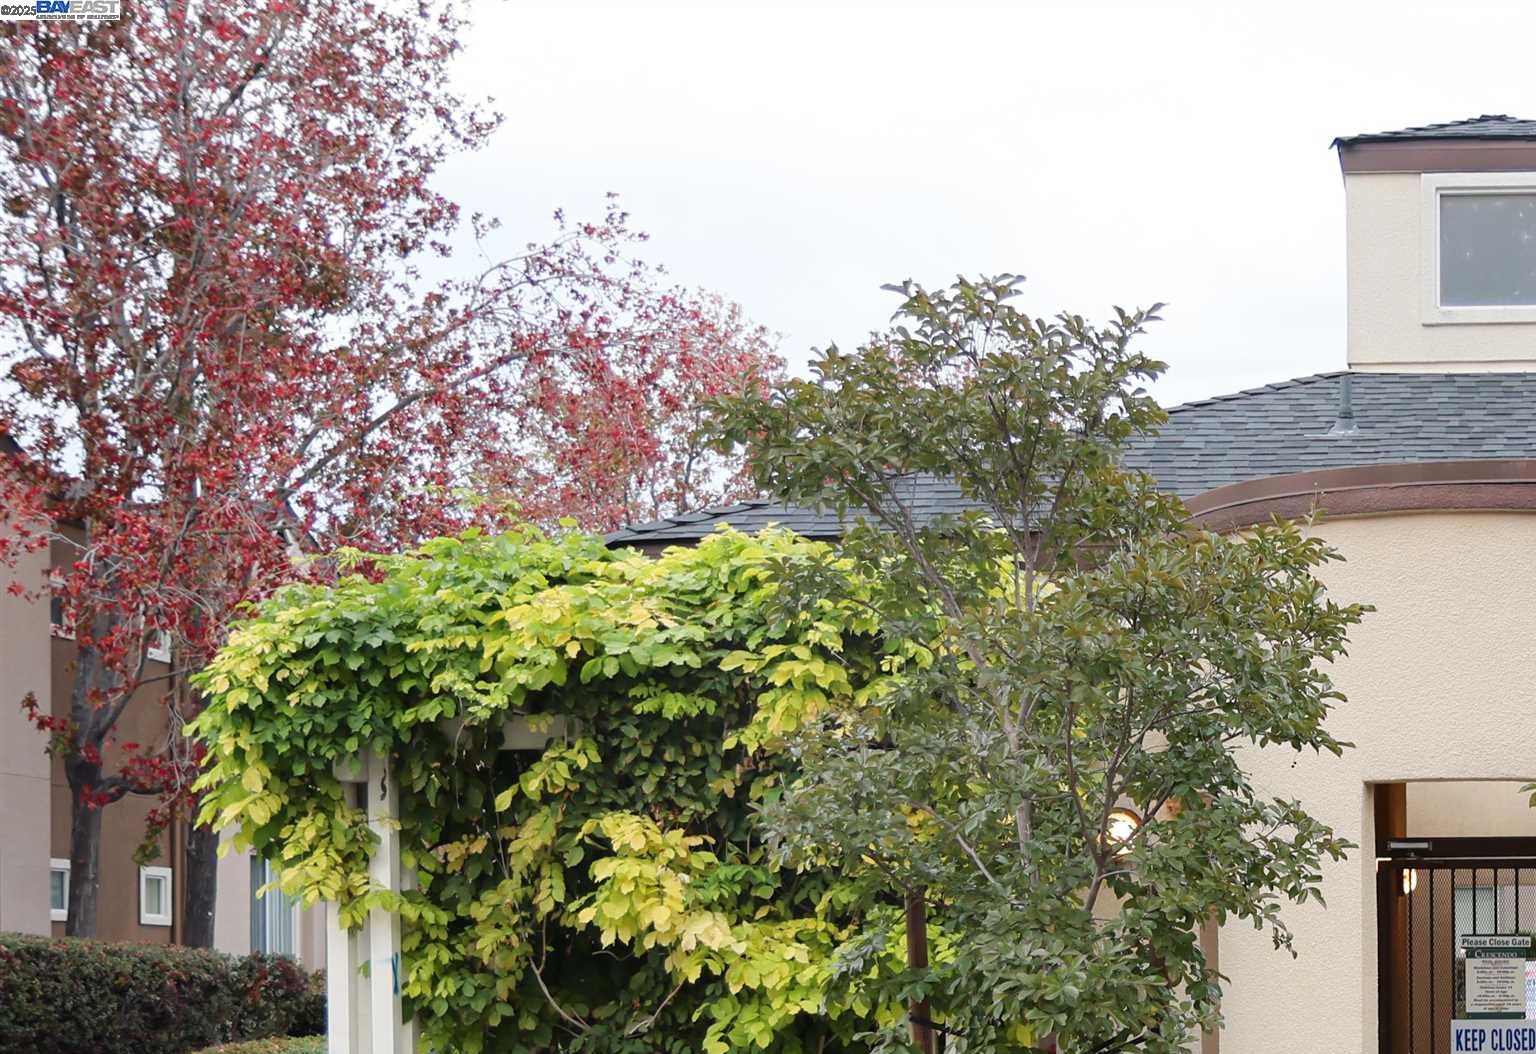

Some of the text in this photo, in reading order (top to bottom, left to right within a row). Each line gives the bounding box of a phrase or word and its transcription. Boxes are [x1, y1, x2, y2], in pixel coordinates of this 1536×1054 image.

[1462, 938, 1530, 946] Please Close Gate
[1456, 1028, 1536, 1051] KEEP CLOSED
